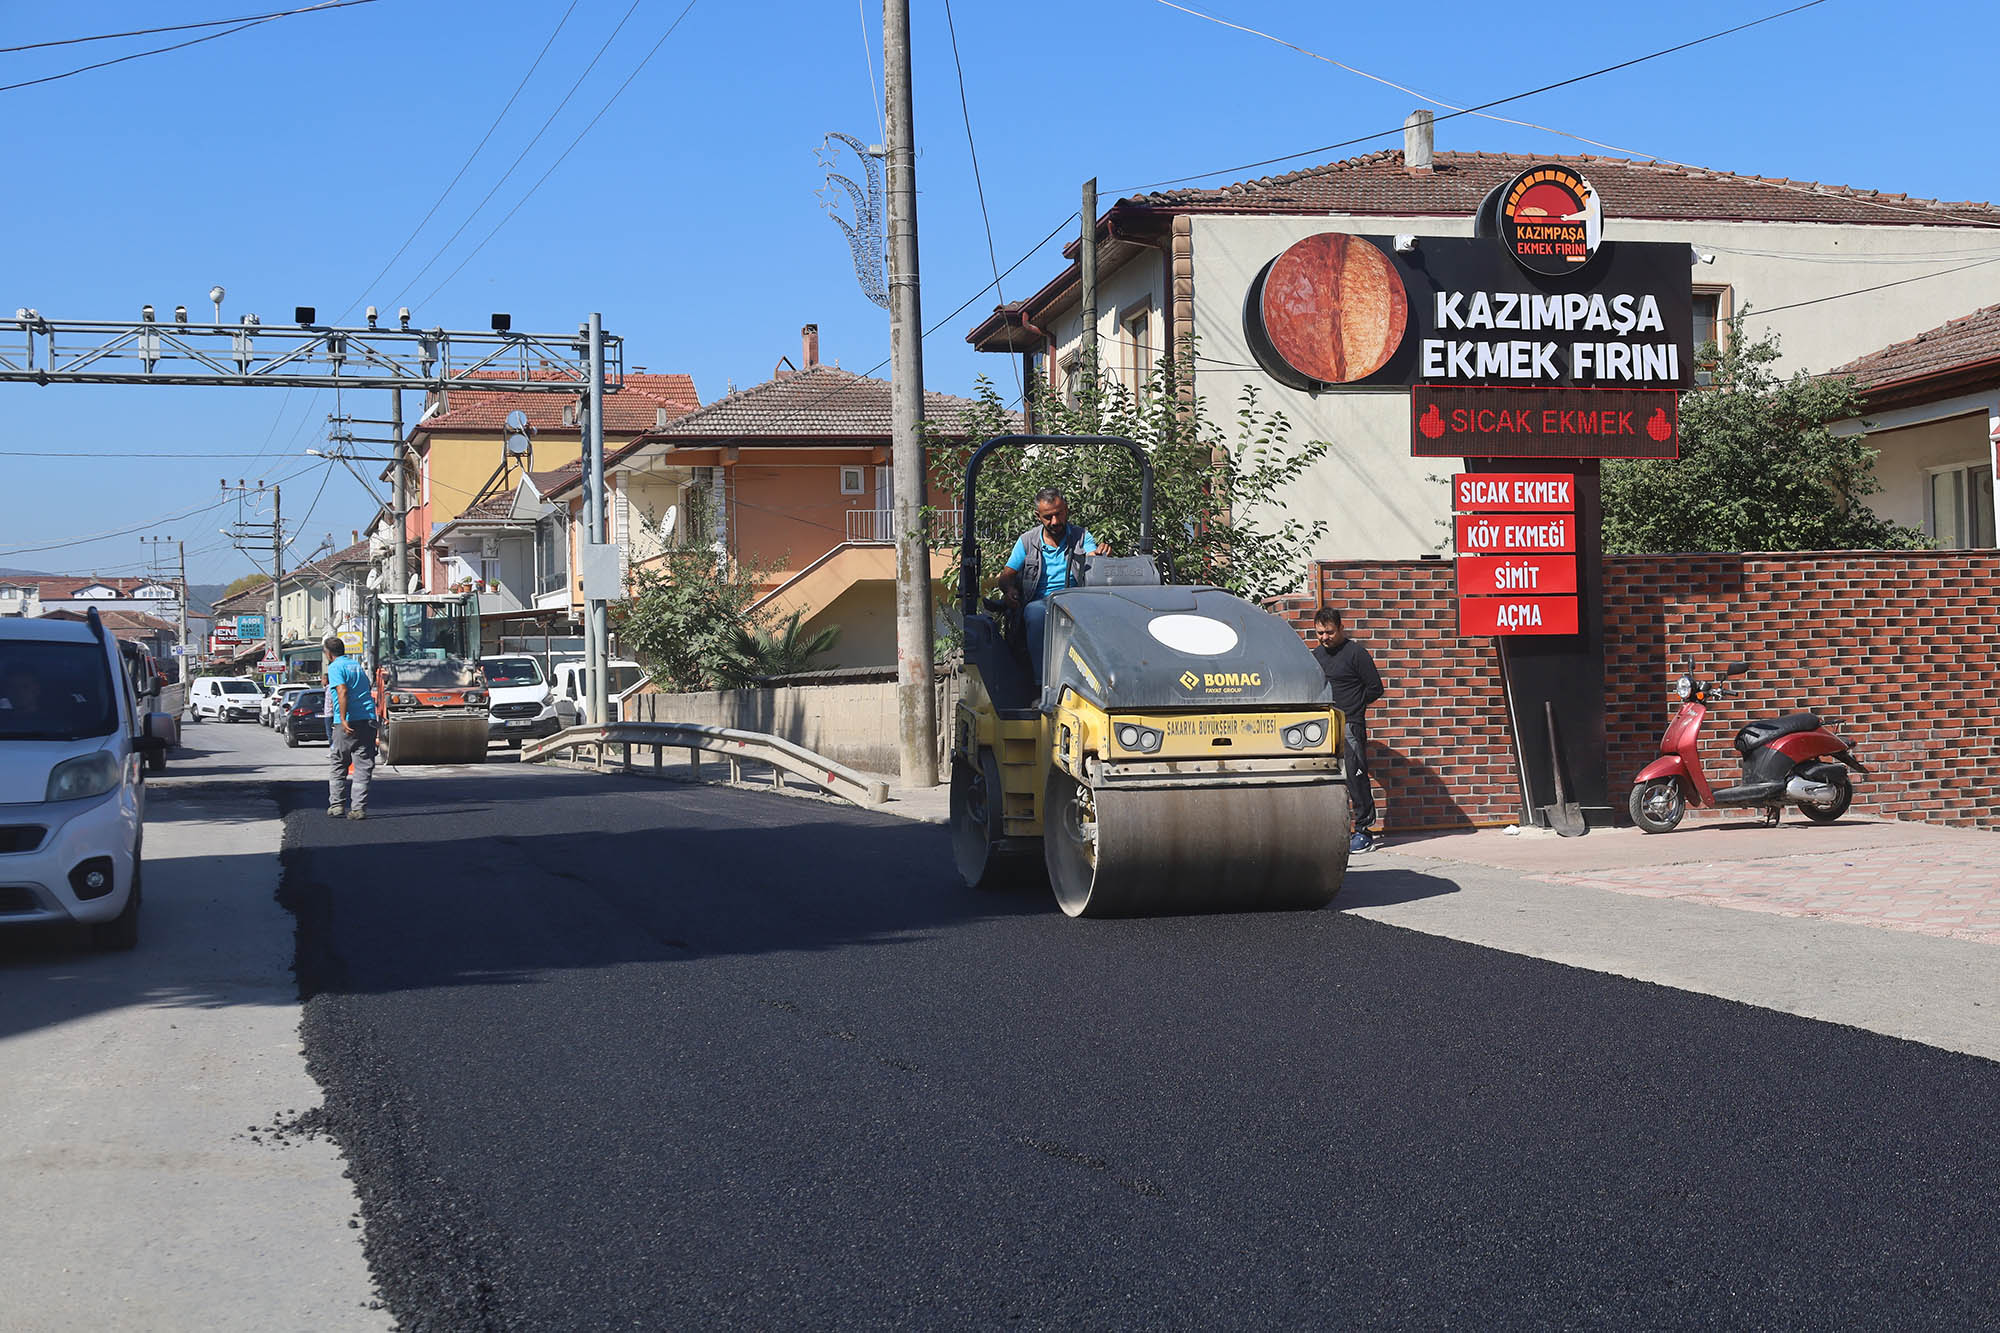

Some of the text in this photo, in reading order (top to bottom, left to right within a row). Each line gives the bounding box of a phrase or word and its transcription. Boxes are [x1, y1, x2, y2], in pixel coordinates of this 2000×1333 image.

[1517, 226, 1585, 243] KAZIMPAŞA
[1517, 242, 1586, 255] EKMEK FIRINI
[1435, 291, 1664, 336] KAZIMPAŞA
[1422, 339, 1680, 381] EKMEK FIRINI
[1451, 408, 1635, 435] SICAK EKMEK
[1460, 481, 1569, 503] SICAK EKMEK
[1467, 520, 1565, 547] KÖY EKMEĞİ
[1495, 561, 1540, 589] SİMİT
[1496, 604, 1543, 631] AÇMA
[1203, 673, 1262, 686] BOMAG
[1166, 721, 1196, 736] SAKARYA
